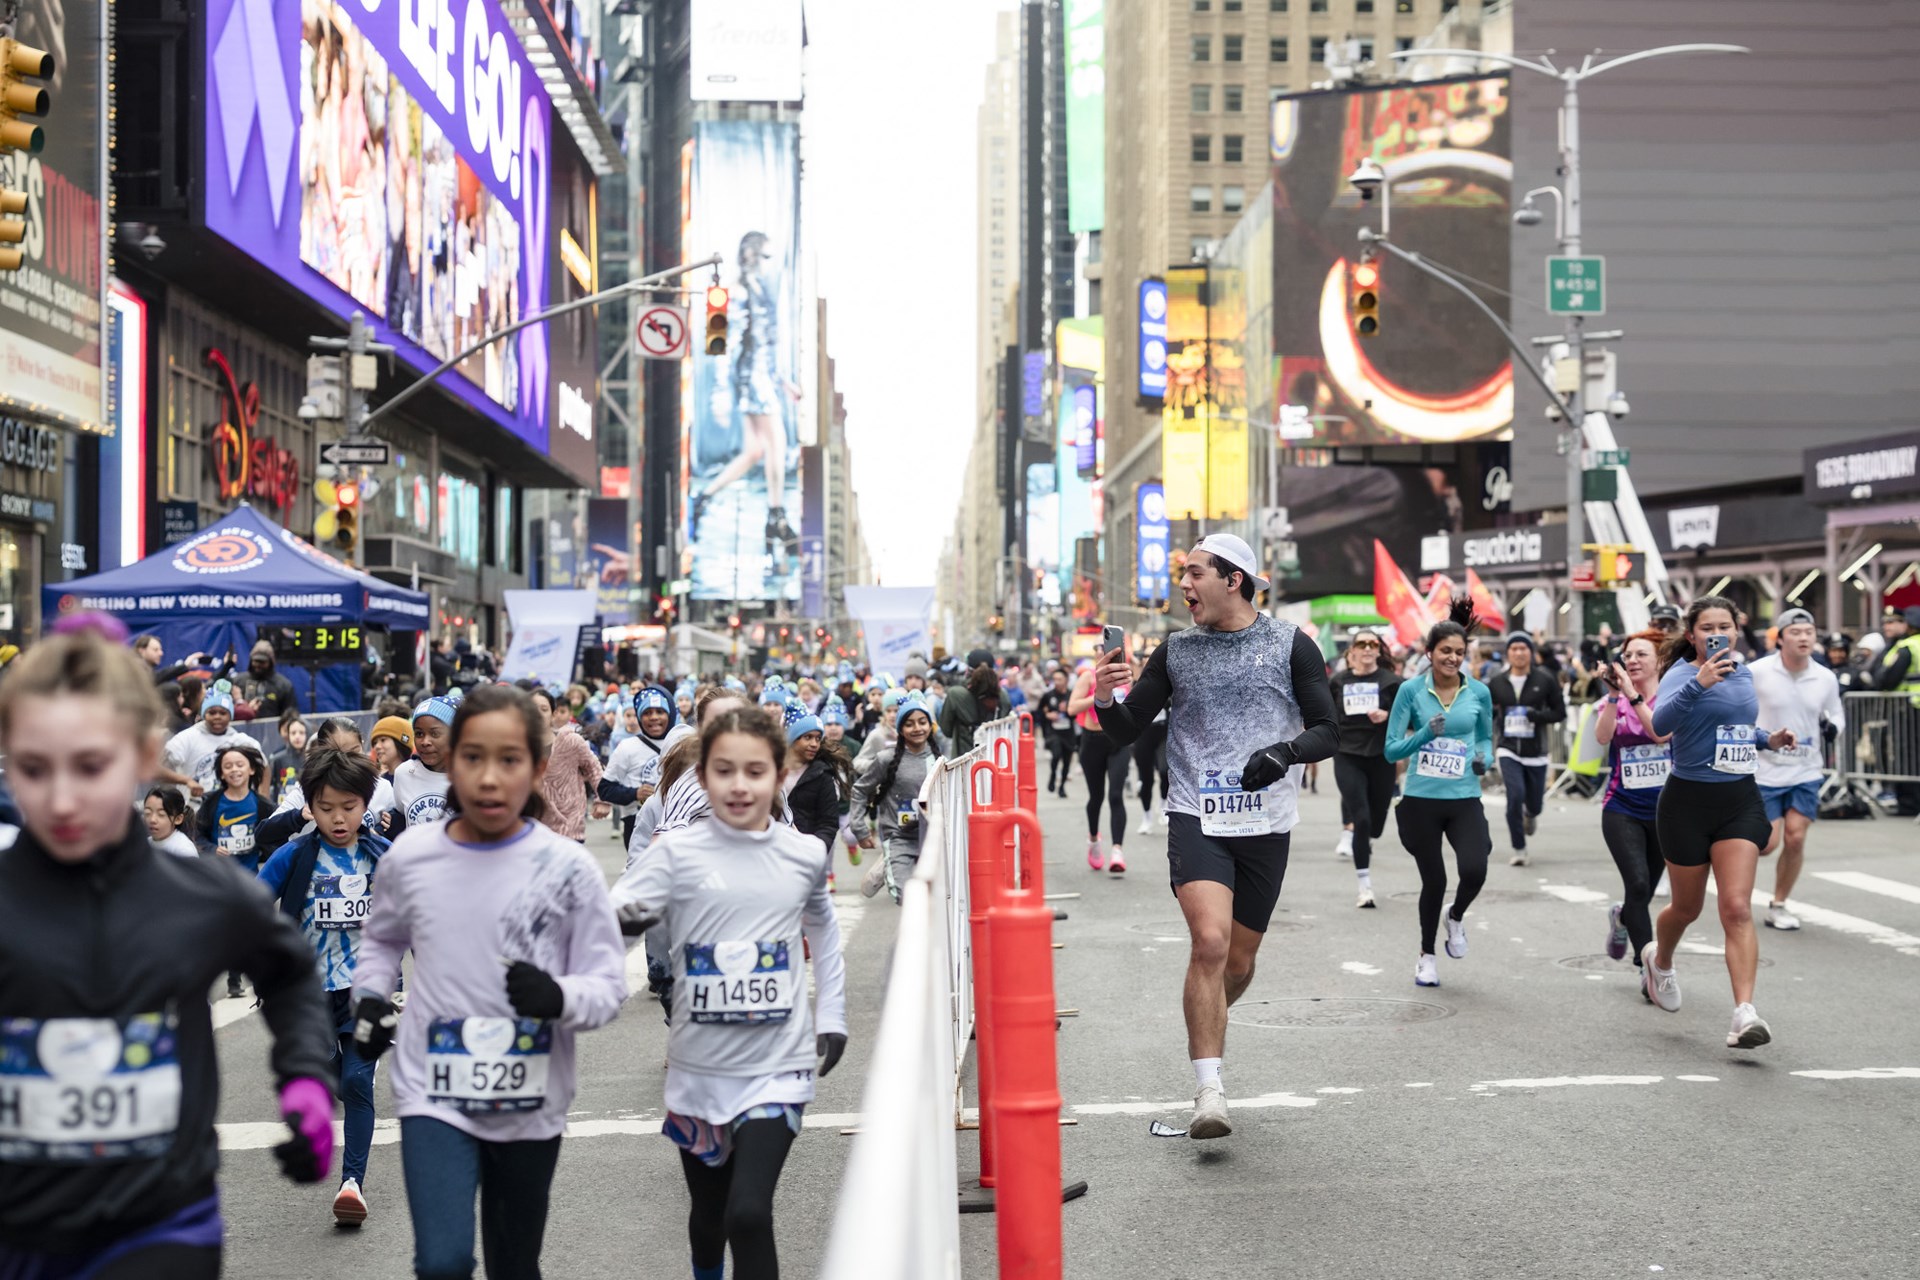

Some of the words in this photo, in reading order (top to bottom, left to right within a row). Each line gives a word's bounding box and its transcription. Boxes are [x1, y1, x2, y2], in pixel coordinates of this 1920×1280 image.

[463, 0, 522, 200] GO!
[0, 417, 58, 474] GGAGE
[1848, 446, 1918, 484] BROADWAY
[1463, 530, 1529, 566] swatch
[82, 597, 136, 610] RISING
[139, 596, 175, 609] NEW
[179, 595, 220, 608] YORK
[223, 595, 266, 608] ROAD
[270, 593, 343, 608] RUNNERS
[1624, 766, 1632, 777] B
[1635, 761, 1666, 778] 12514
[409, 800, 427, 822] STAR
[235, 838, 252, 850] 514
[319, 902, 332, 919] H
[693, 984, 709, 1009] H
[718, 978, 778, 1006] 1456
[433, 1064, 451, 1092] H
[472, 1062, 527, 1092] 529
[60, 1086, 138, 1129] 391
